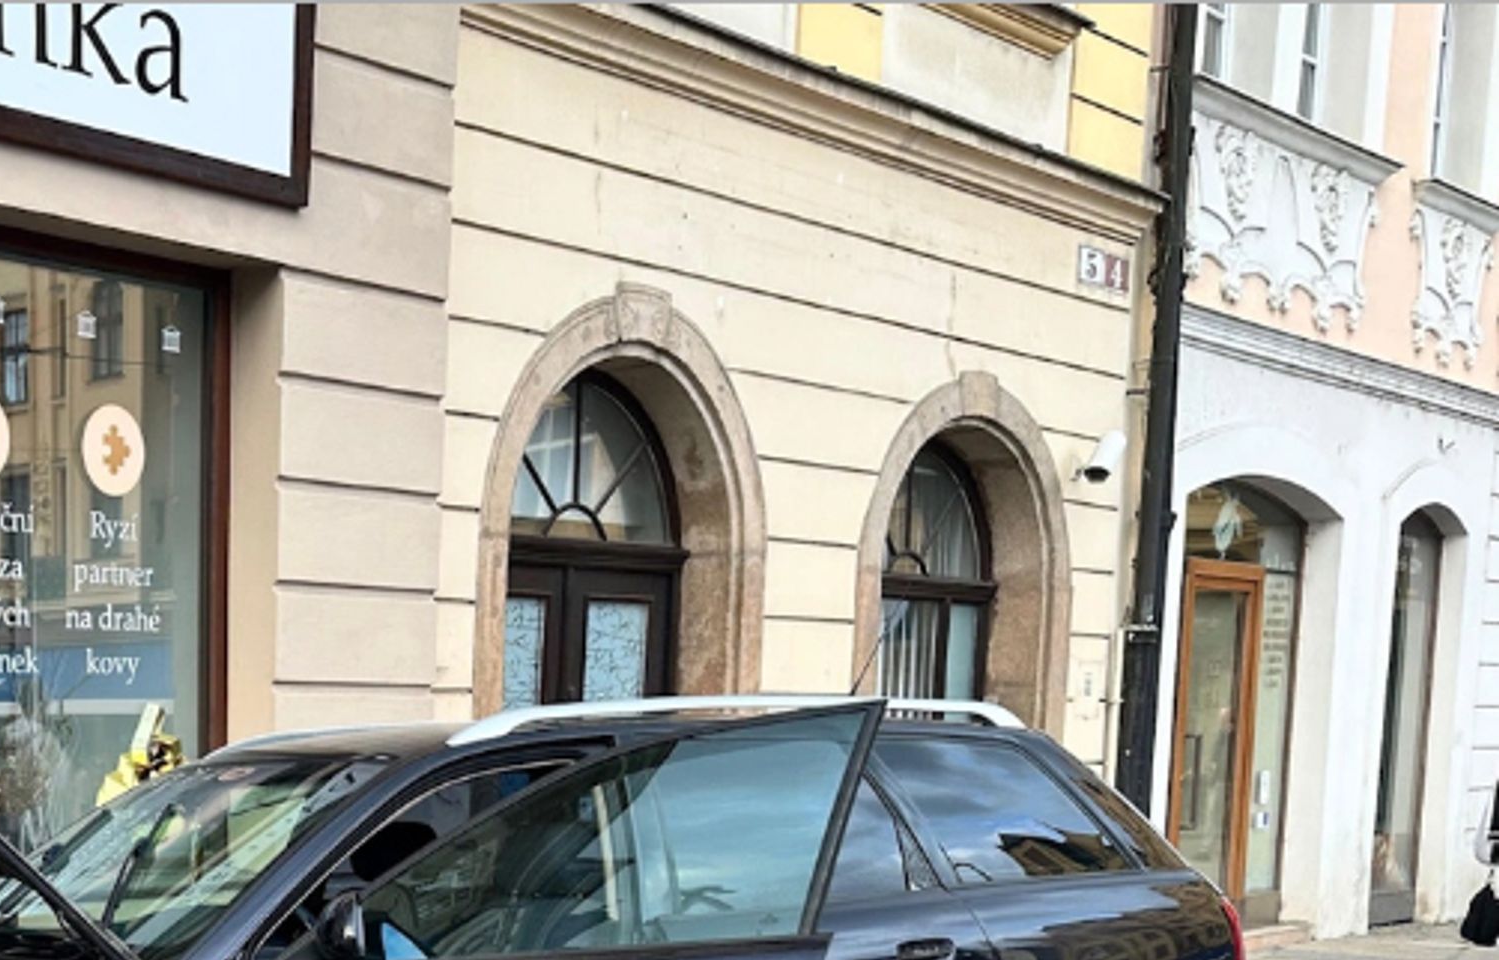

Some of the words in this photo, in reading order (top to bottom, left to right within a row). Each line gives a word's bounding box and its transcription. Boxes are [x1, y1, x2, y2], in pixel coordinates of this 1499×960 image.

[90, 510, 139, 548] Ryzí
[73, 562, 155, 592] partner
[65, 607, 93, 631] na
[98, 604, 161, 633] drahé
[85, 647, 141, 686] kovy
